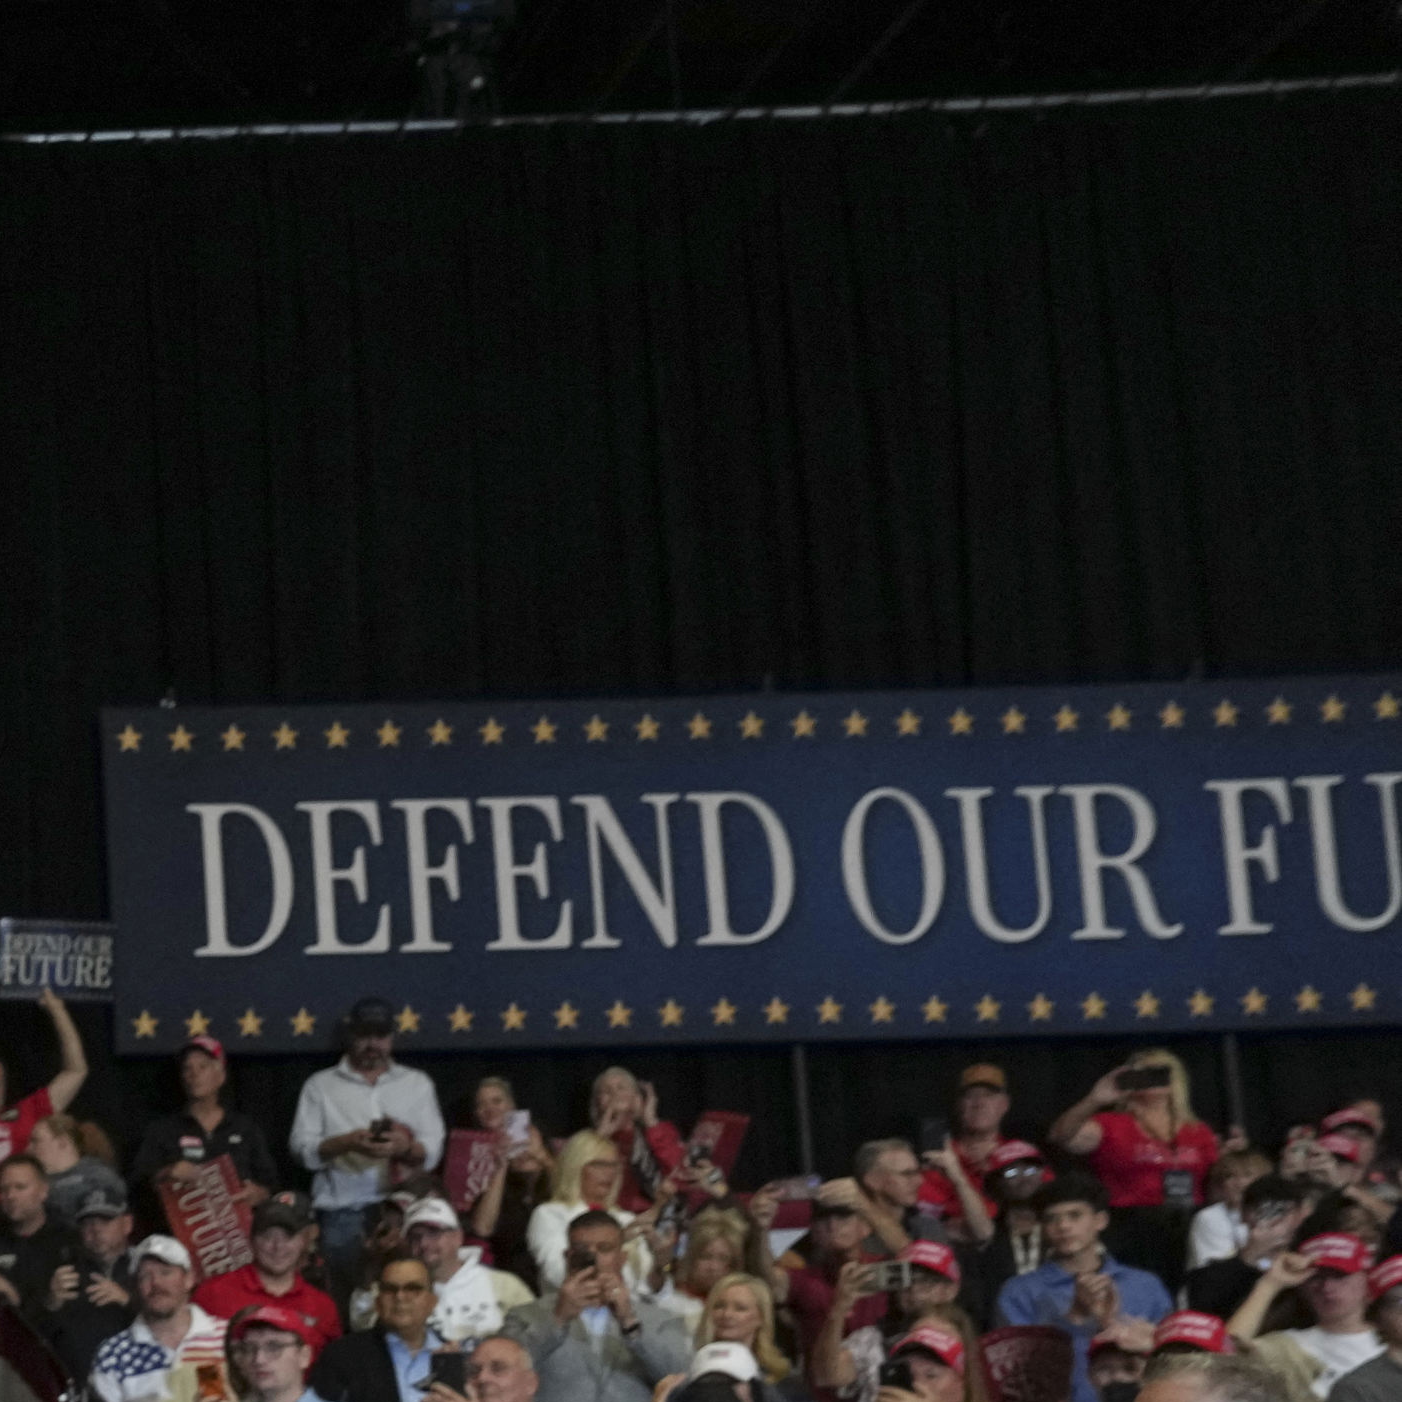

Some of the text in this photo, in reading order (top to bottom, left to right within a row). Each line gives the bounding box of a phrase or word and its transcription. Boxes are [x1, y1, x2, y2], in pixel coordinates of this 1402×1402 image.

[186, 772, 1402, 958] DEFEND OUR FU
[3, 954, 113, 988] FUTURE
